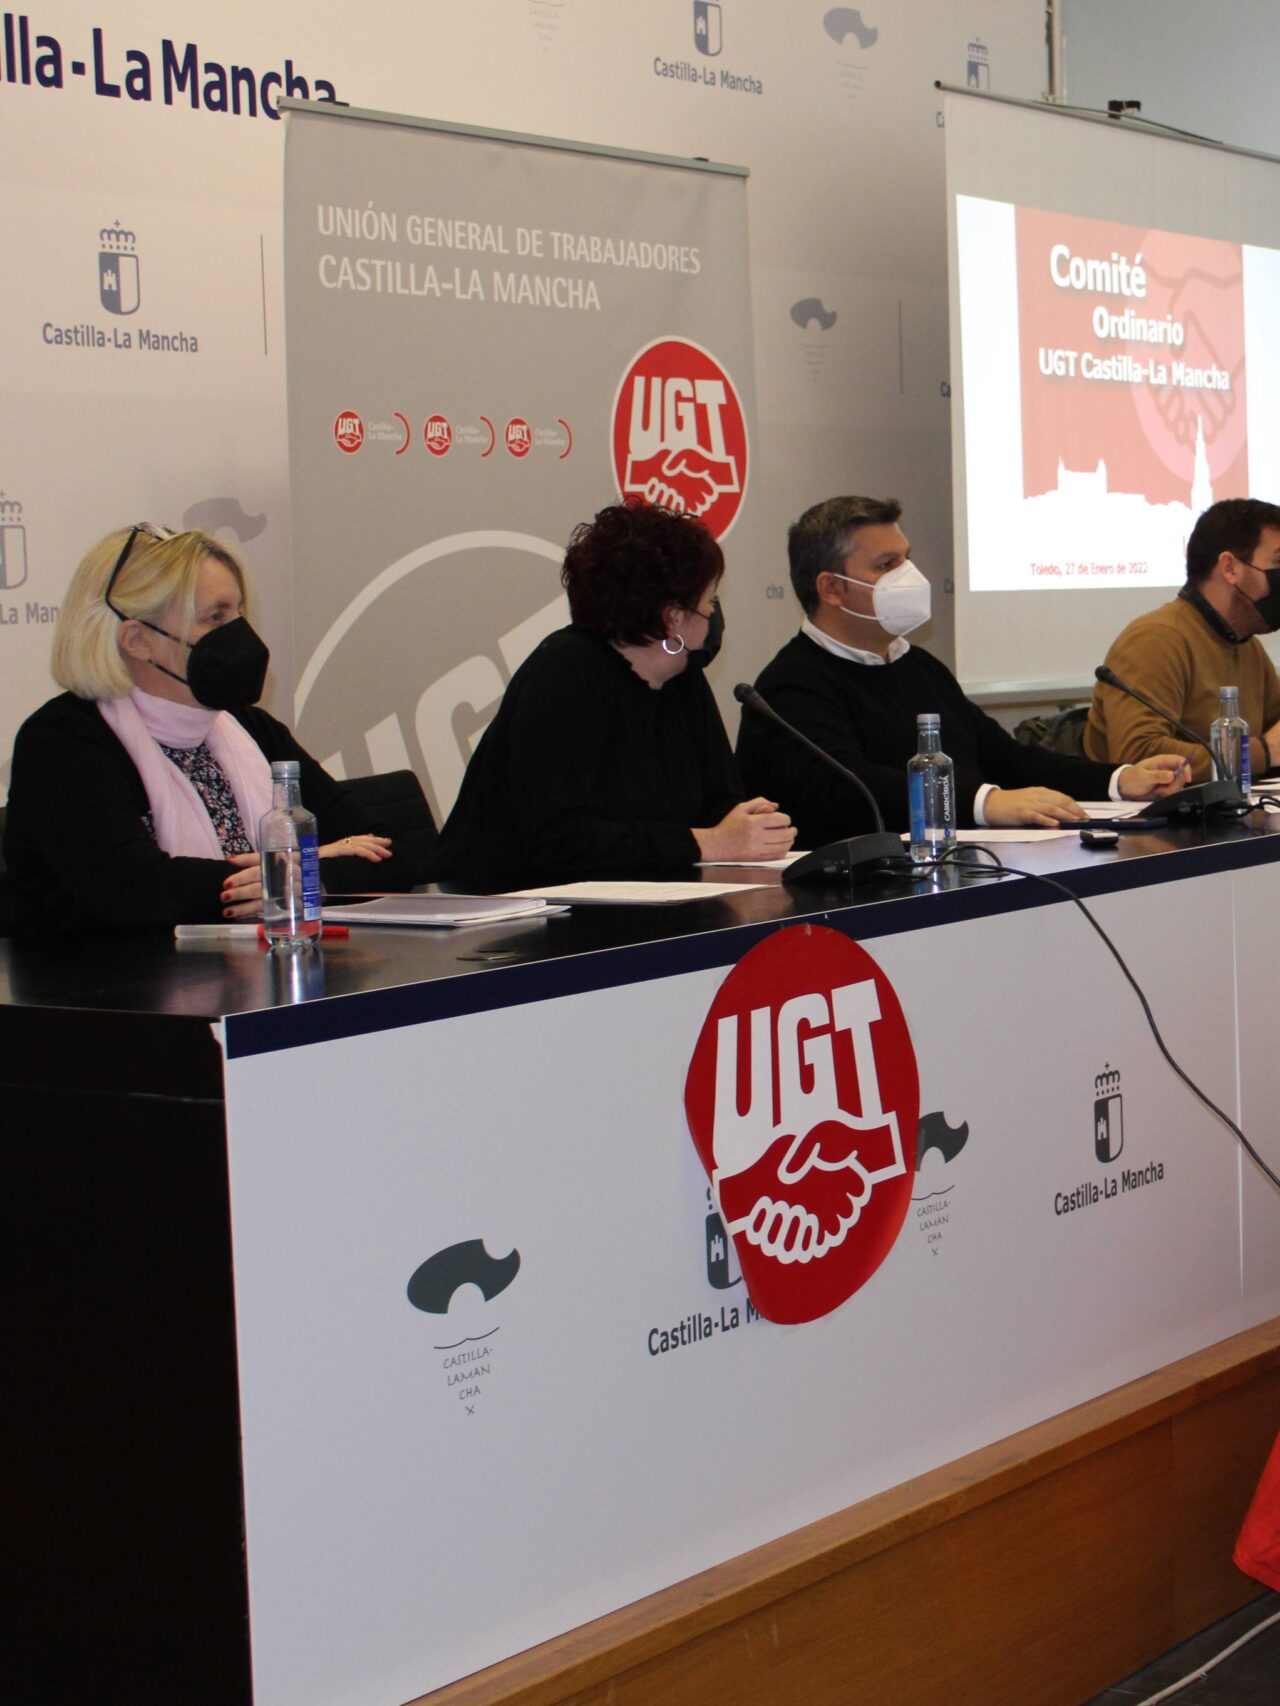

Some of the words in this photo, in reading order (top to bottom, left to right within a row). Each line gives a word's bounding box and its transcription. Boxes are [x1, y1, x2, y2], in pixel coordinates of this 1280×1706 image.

[0, 12, 152, 102] lla-La
[653, 57, 716, 87] Castilla-La
[720, 70, 763, 95] Mancha
[317, 201, 398, 243] UNIÓN
[406, 215, 509, 254] GENERAL
[516, 227, 544, 259] DE
[550, 231, 701, 275] TRABAJADORES
[318, 254, 484, 302] CASTILLA-LA
[493, 271, 601, 312] MANCHA
[1050, 244, 1147, 298] Comité
[42, 322, 132, 349] Castilla-La
[138, 329, 199, 353] Mancha
[1092, 306, 1184, 346] Ordinario
[1038, 347, 1078, 377] UGT
[1081, 352, 1167, 385] Castilla-La
[1171, 361, 1230, 390] Mancha
[338, 418, 361, 436] UGT
[427, 421, 449, 439] UGT
[507, 424, 529, 441] UGT
[629, 375, 728, 458] UGT
[1077, 562, 1089, 576] de
[26, 602, 60, 624] Man
[713, 978, 882, 1166] UGT
[1054, 1177, 1117, 1216] Castilla-La
[1122, 1161, 1165, 1192] Mancha
[928, 1232, 943, 1244] CHA
[648, 1306, 739, 1356] Castilla-La
[443, 1346, 493, 1369] CASTILLA-
[447, 1363, 490, 1386] LAMAN
[459, 1385, 481, 1400] CHA
